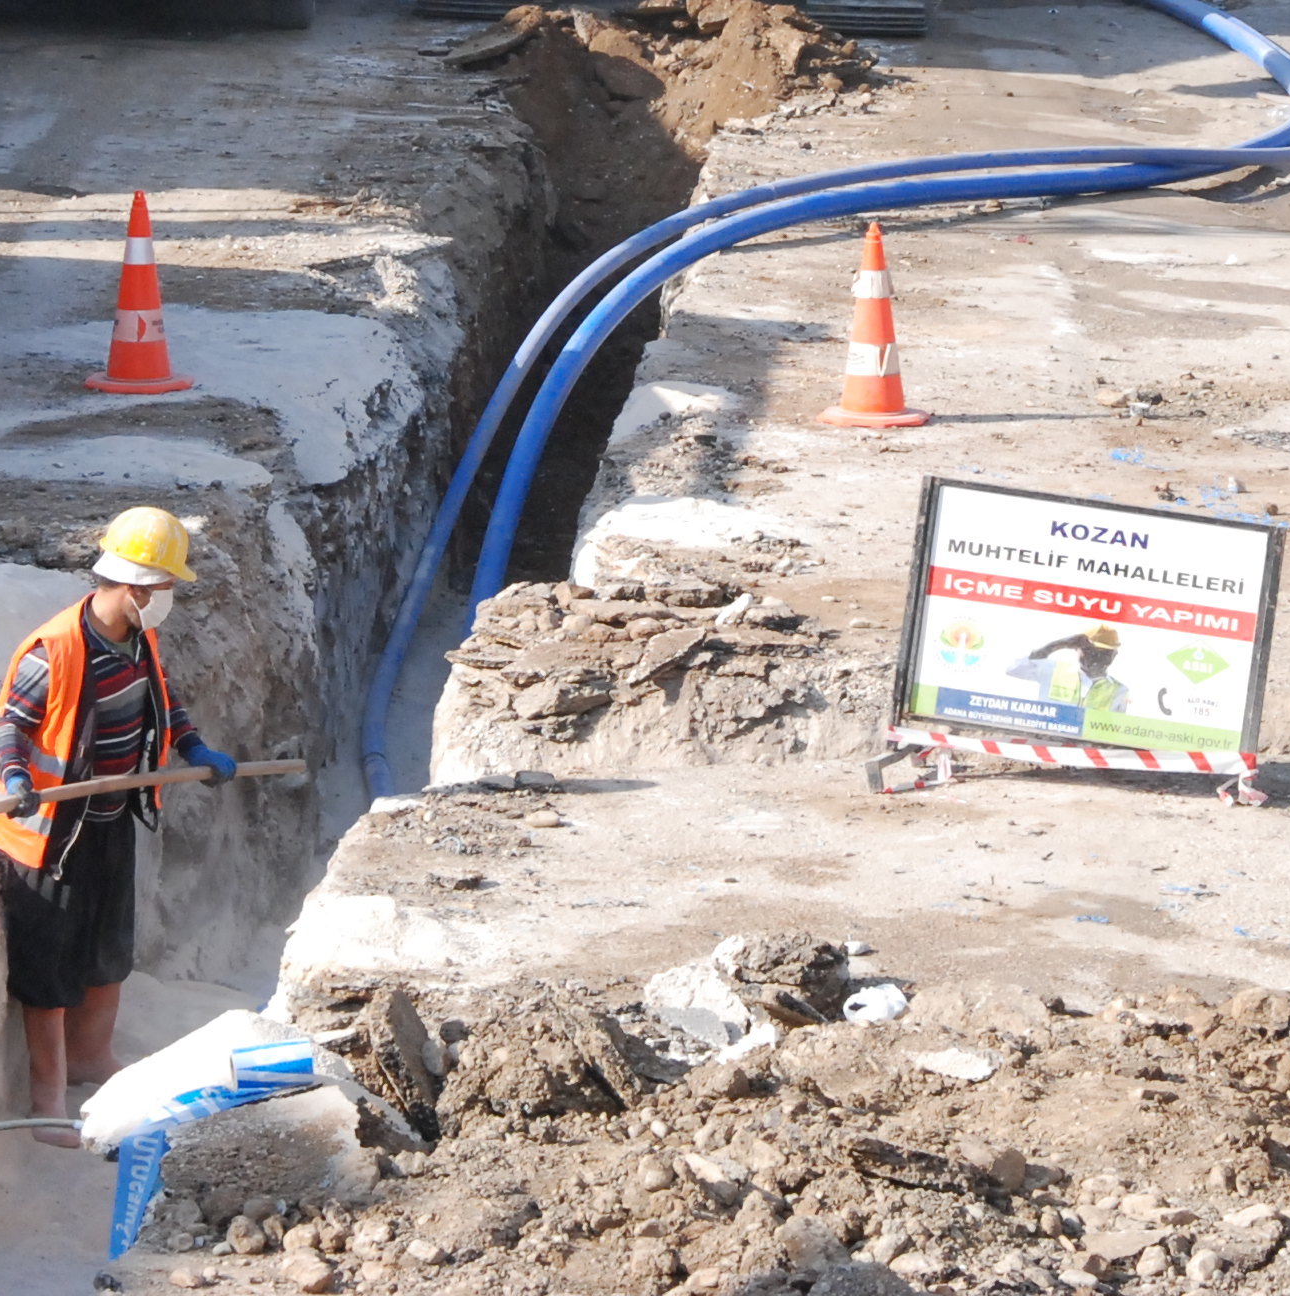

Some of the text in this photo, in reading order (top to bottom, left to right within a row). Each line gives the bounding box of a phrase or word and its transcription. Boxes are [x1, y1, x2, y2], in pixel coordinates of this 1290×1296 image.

[1050, 520, 1149, 550] KOZAN
[948, 538, 1245, 595] MUHTELİF MAHALLELERİ
[1033, 589, 1122, 614] SUYU
[1131, 603, 1239, 632] YAPIMI
[969, 695, 1057, 718] ZEYDAN KARALAR
[1090, 720, 1233, 751] www.adana-aski.gov.tr
